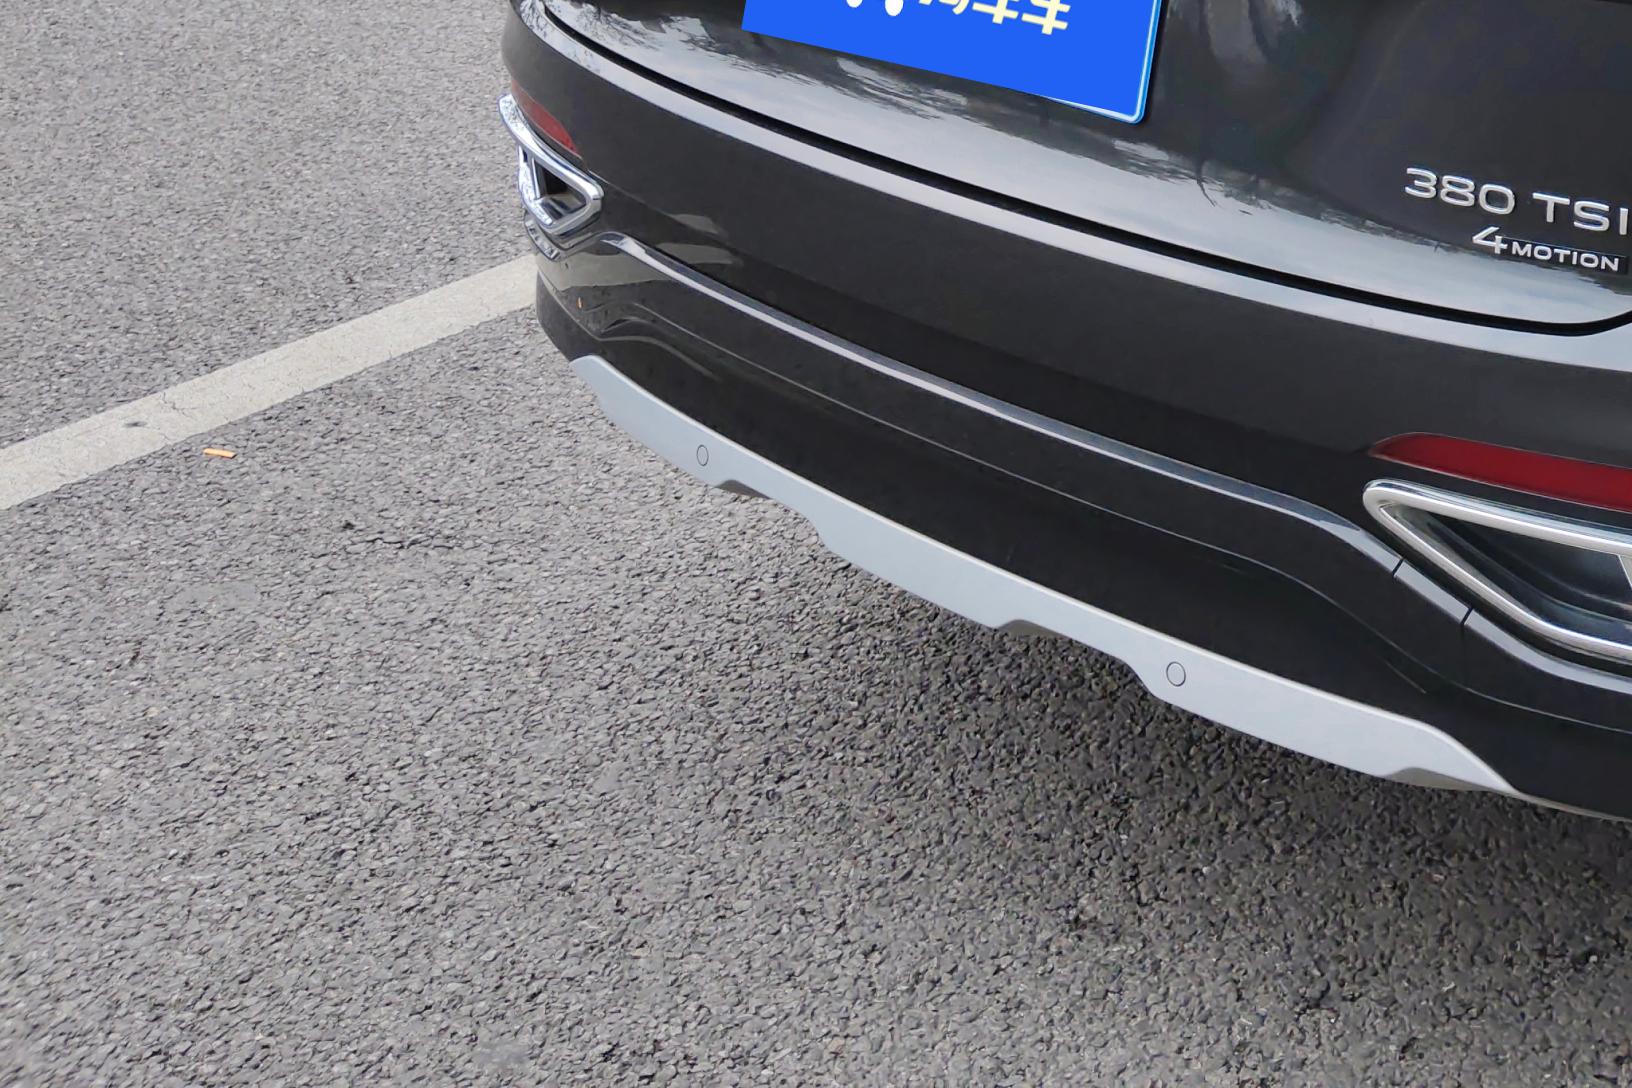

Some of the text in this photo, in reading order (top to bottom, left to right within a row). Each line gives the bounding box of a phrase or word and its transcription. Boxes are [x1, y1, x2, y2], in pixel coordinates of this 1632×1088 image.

[1404, 167, 1629, 236] 380 TSI
[1472, 226, 1619, 272] 4MOTION
